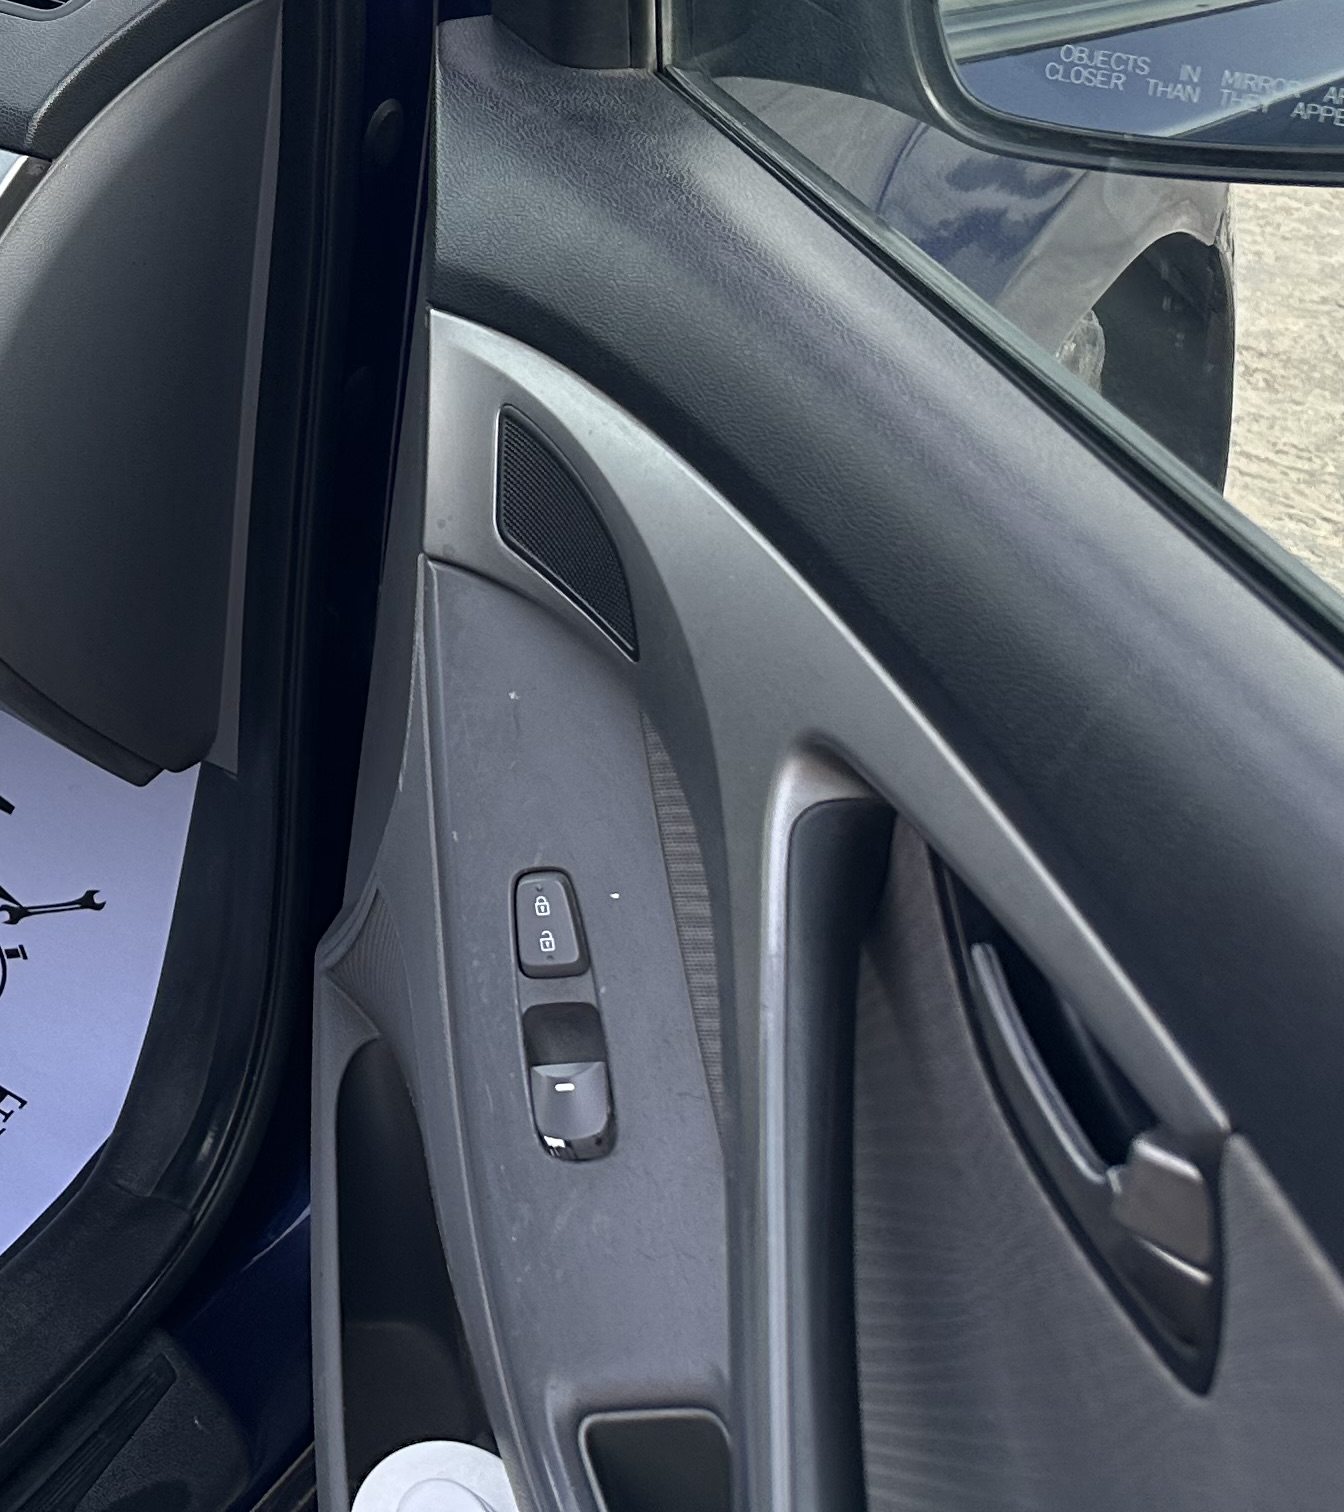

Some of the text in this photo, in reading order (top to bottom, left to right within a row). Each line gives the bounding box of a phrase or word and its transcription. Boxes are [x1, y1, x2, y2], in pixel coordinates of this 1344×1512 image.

[1045, 62, 1127, 91] CLOSER
[1146, 78, 1201, 104] THAN
[1060, 44, 1151, 76] OBJECTS
[1179, 64, 1202, 85] IN
